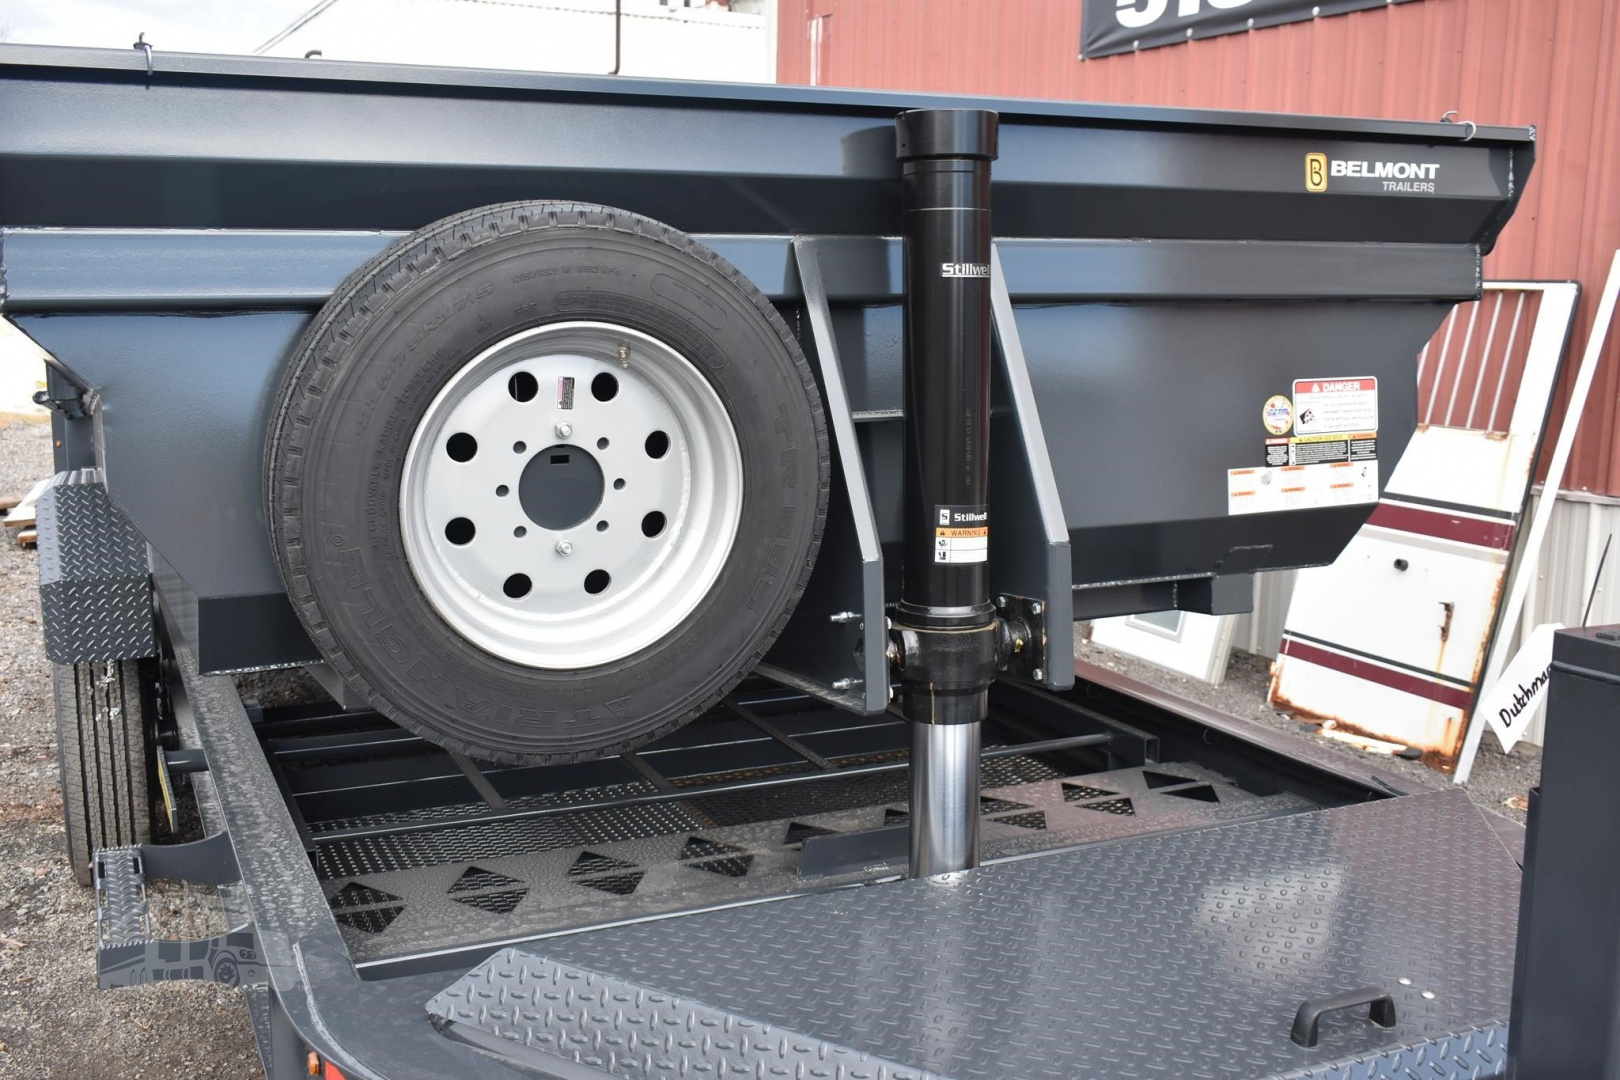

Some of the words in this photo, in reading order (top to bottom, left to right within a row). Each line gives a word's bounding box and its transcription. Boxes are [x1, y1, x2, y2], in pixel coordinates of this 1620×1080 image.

[1331, 160, 1440, 179] BELMONT
[1382, 181, 1435, 193] TRAILERS
[1323, 381, 1360, 393] DANGER
